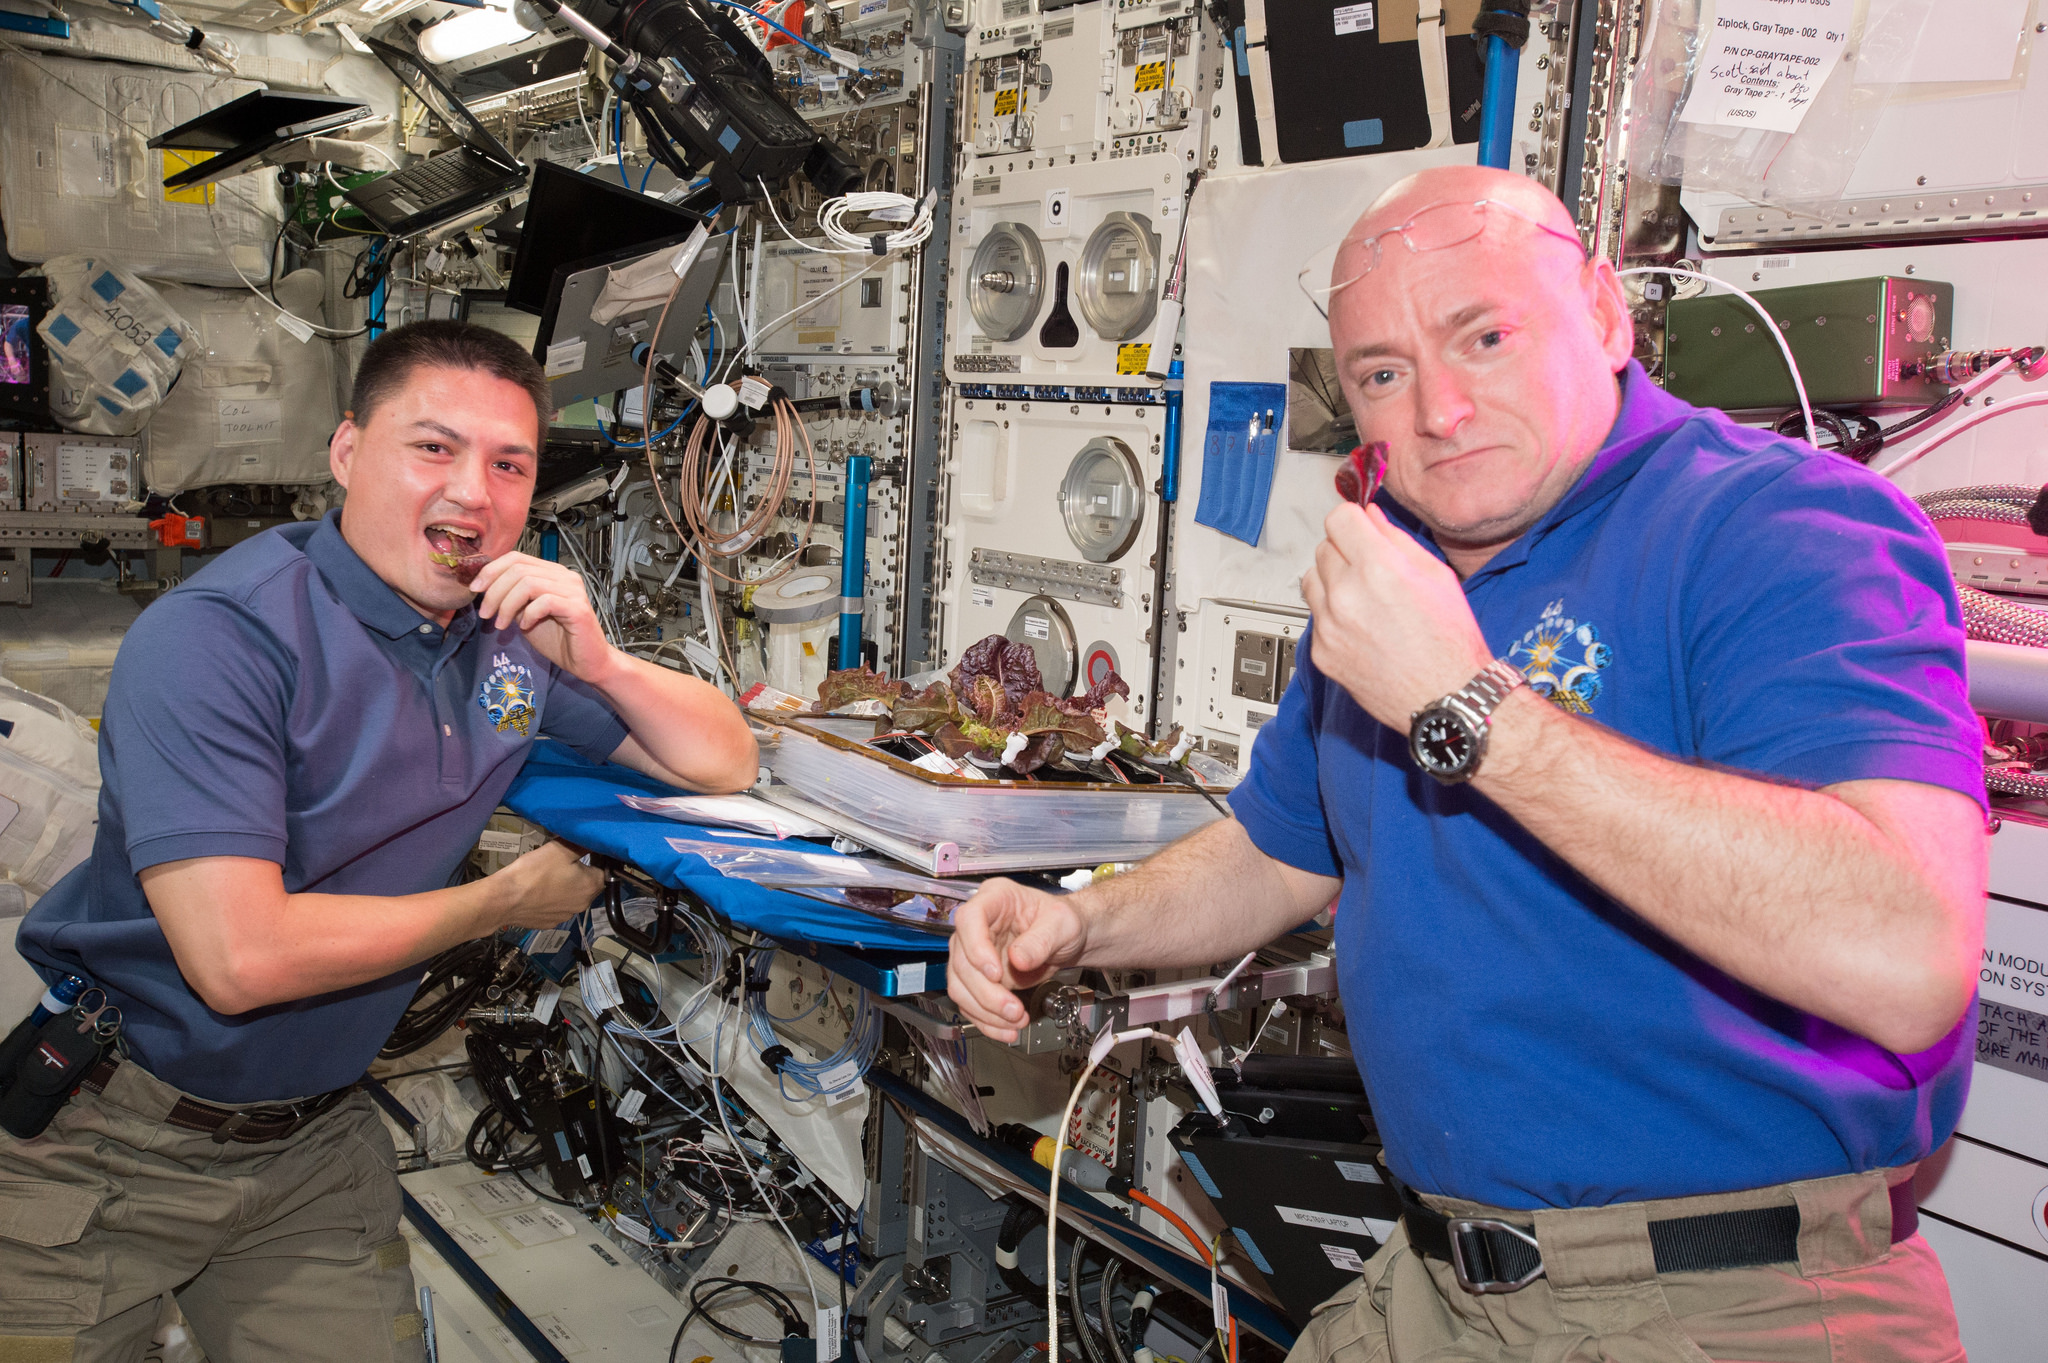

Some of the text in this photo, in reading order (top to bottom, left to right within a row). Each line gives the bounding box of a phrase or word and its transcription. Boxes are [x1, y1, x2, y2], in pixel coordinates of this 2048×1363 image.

[1717, 17, 1751, 31] Ziplock,
[1752, 22, 1773, 34] Gray
[1774, 24, 1795, 36] Tape
[1801, 27, 1818, 38] 002
[1825, 31, 1839, 42] Qty
[1840, 33, 1845, 41] 1
[1723, 46, 1821, 66] P/N CP-GRAYTAPE-002
[1710, 61, 1810, 80] Scott said about
[1724, 85, 1742, 97] Gray
[1744, 87, 1764, 99] Tape
[1460, 99, 1482, 124] ThinkPad
[1727, 108, 1757, 119] (USOS)
[103, 306, 152, 347] 4053
[221, 405, 250, 417] COL
[224, 419, 280, 433] TOOLKIT
[1210, 434, 1220, 456] 8
[1998, 952, 2048, 978] MODU
[1980, 968, 2005, 986] ON
[1979, 1002, 2027, 1027] TACH
[1978, 1020, 2041, 1046] OF THE
[1080, 1137, 1092, 1148] RACK
[1327, 1216, 1349, 1228] LAPTOP
